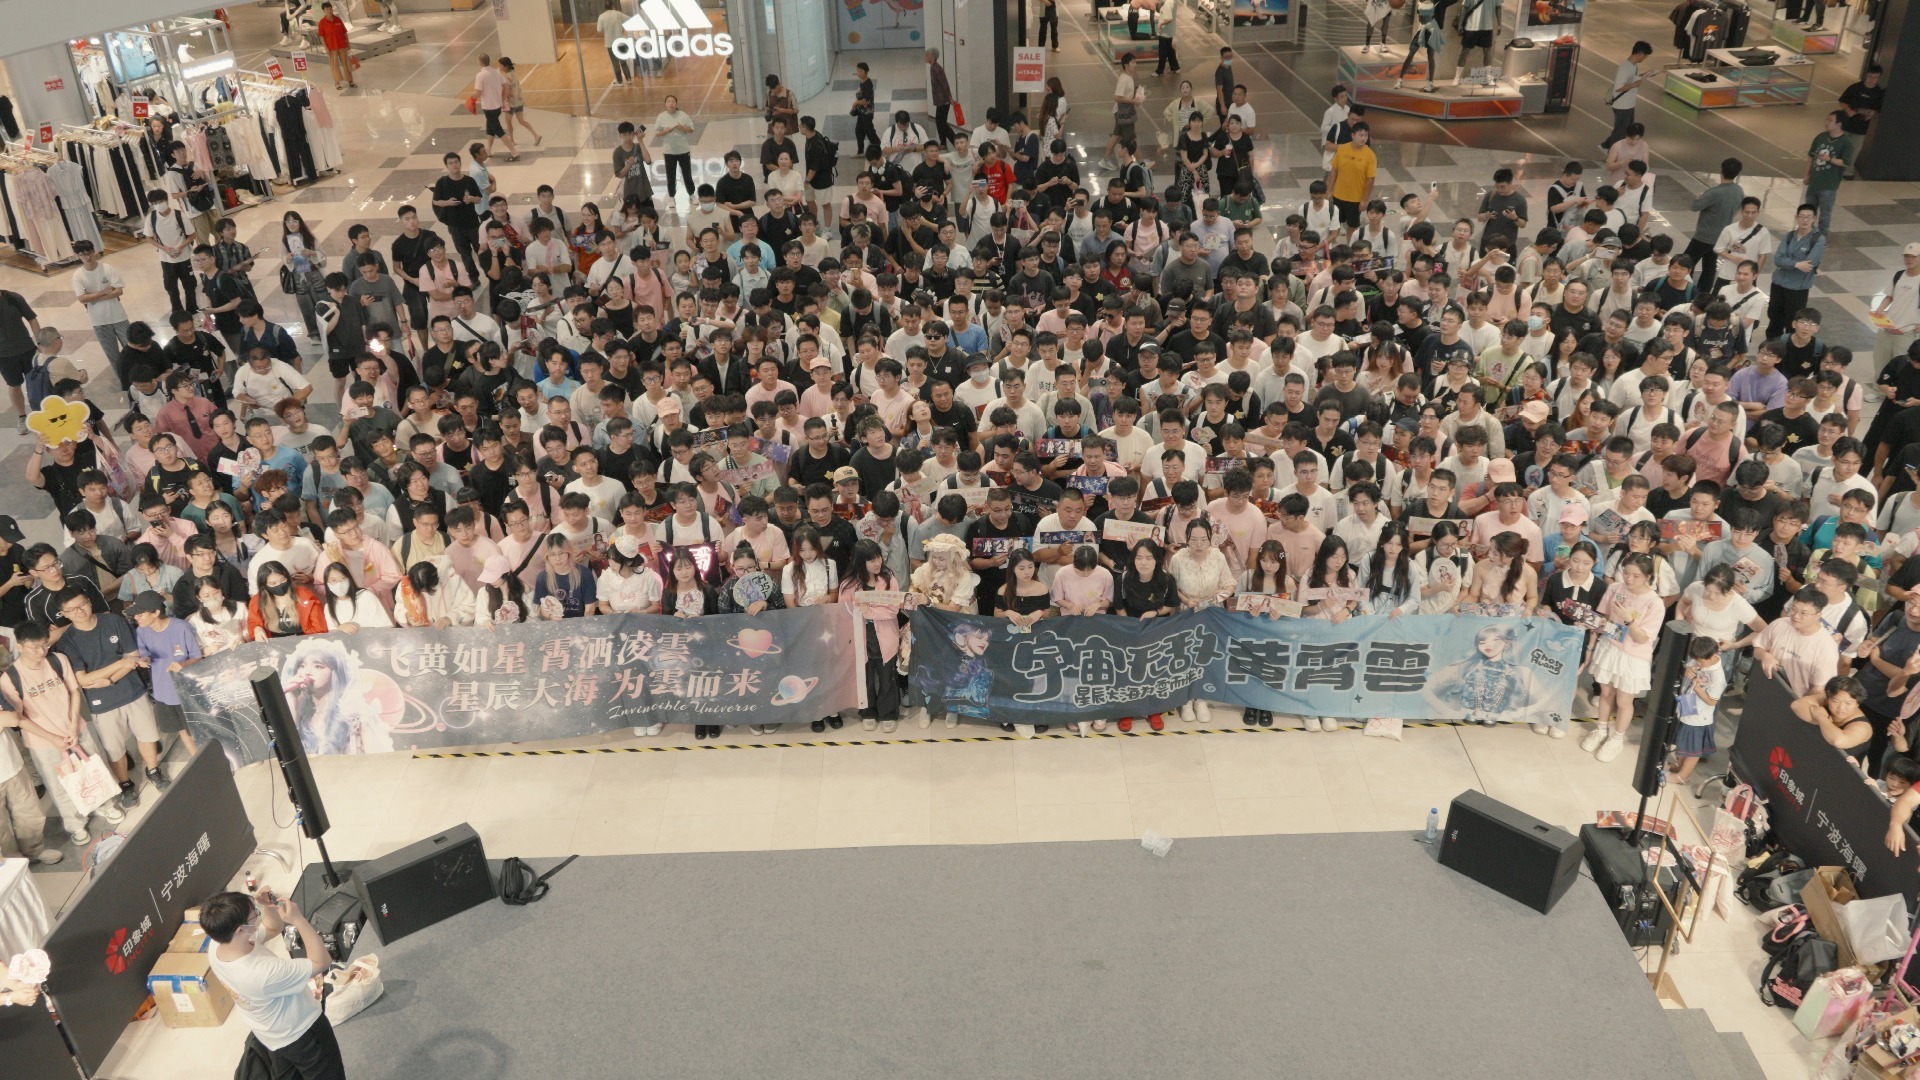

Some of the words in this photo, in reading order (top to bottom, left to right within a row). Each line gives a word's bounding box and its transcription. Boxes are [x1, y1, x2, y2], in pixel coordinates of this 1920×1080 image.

[611, 27, 734, 60] adidas
[390, 641, 527, 677] 飞黄如星
[539, 630, 694, 673] 霄洒凌雲
[1012, 623, 1226, 703] 宇宙无敌
[1225, 636, 1430, 693] 黄霄雲
[1530, 648, 1564, 669] Ghost
[446, 674, 600, 713] 星辰大海
[608, 667, 763, 704] 为雲而来
[607, 700, 688, 720] Invincible
[690, 698, 758, 715] Universe
[1779, 768, 1805, 806] 印象城
[161, 831, 211, 902] 宁波海曙
[1817, 809, 1868, 882] 宁波海曙
[122, 914, 152, 957] 印象城
